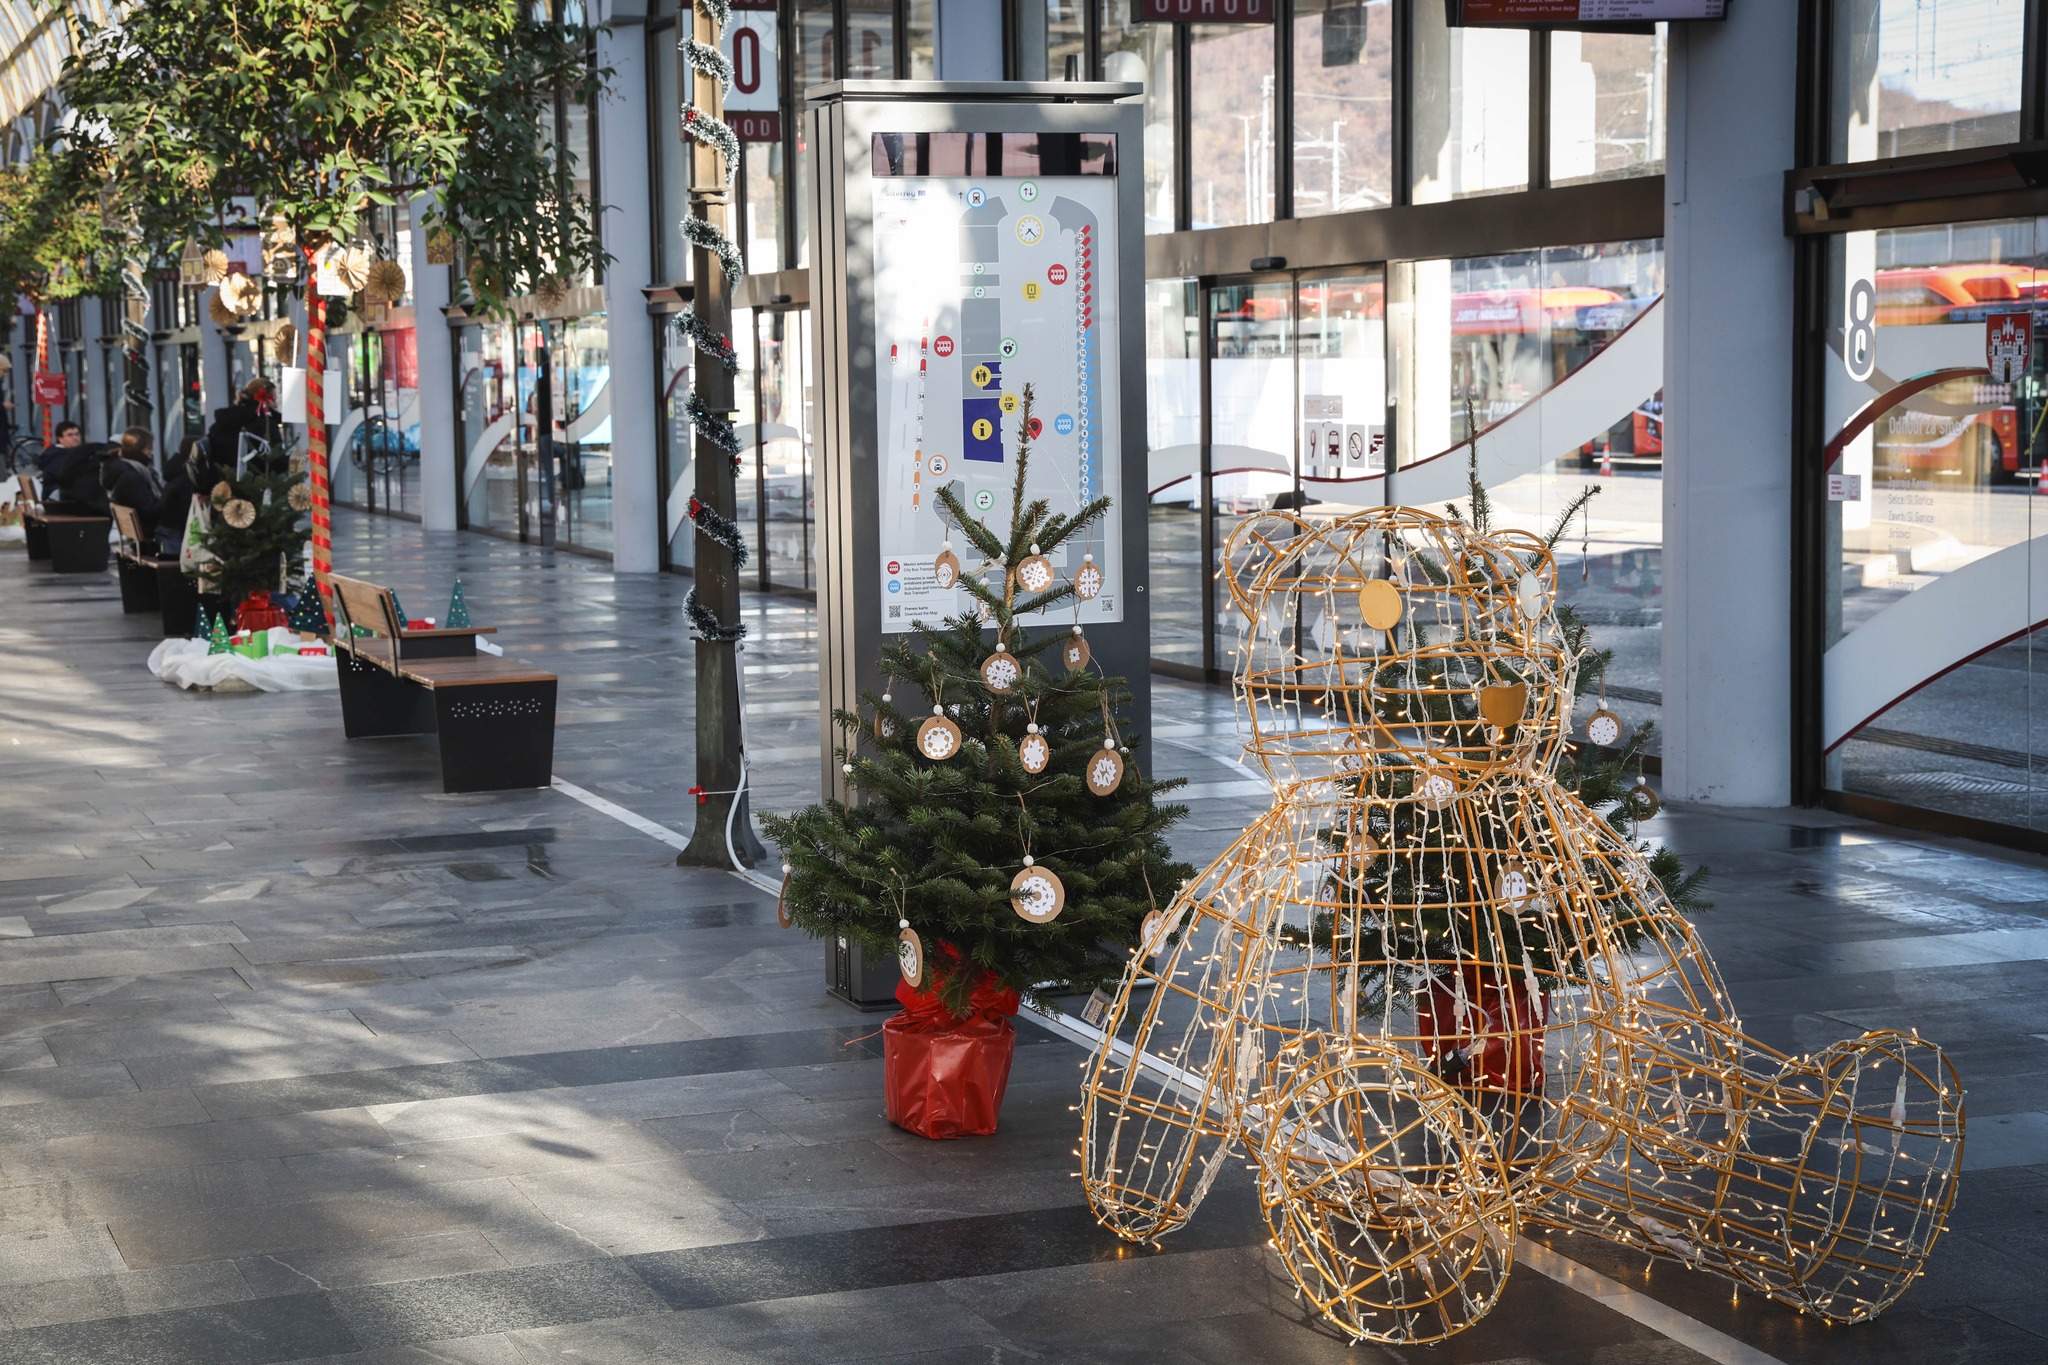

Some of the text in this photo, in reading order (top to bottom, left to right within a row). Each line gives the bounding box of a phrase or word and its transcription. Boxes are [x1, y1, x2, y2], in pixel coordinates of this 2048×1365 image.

[1155, 0, 1260, 14] ODHOD
[733, 27, 760, 94] 0
[727, 119, 770, 136] HOD
[1848, 279, 1876, 376] 8
[664, 325, 678, 370] 10
[1926, 422, 1936, 434] za
[1311, 430, 1316, 458] 9
